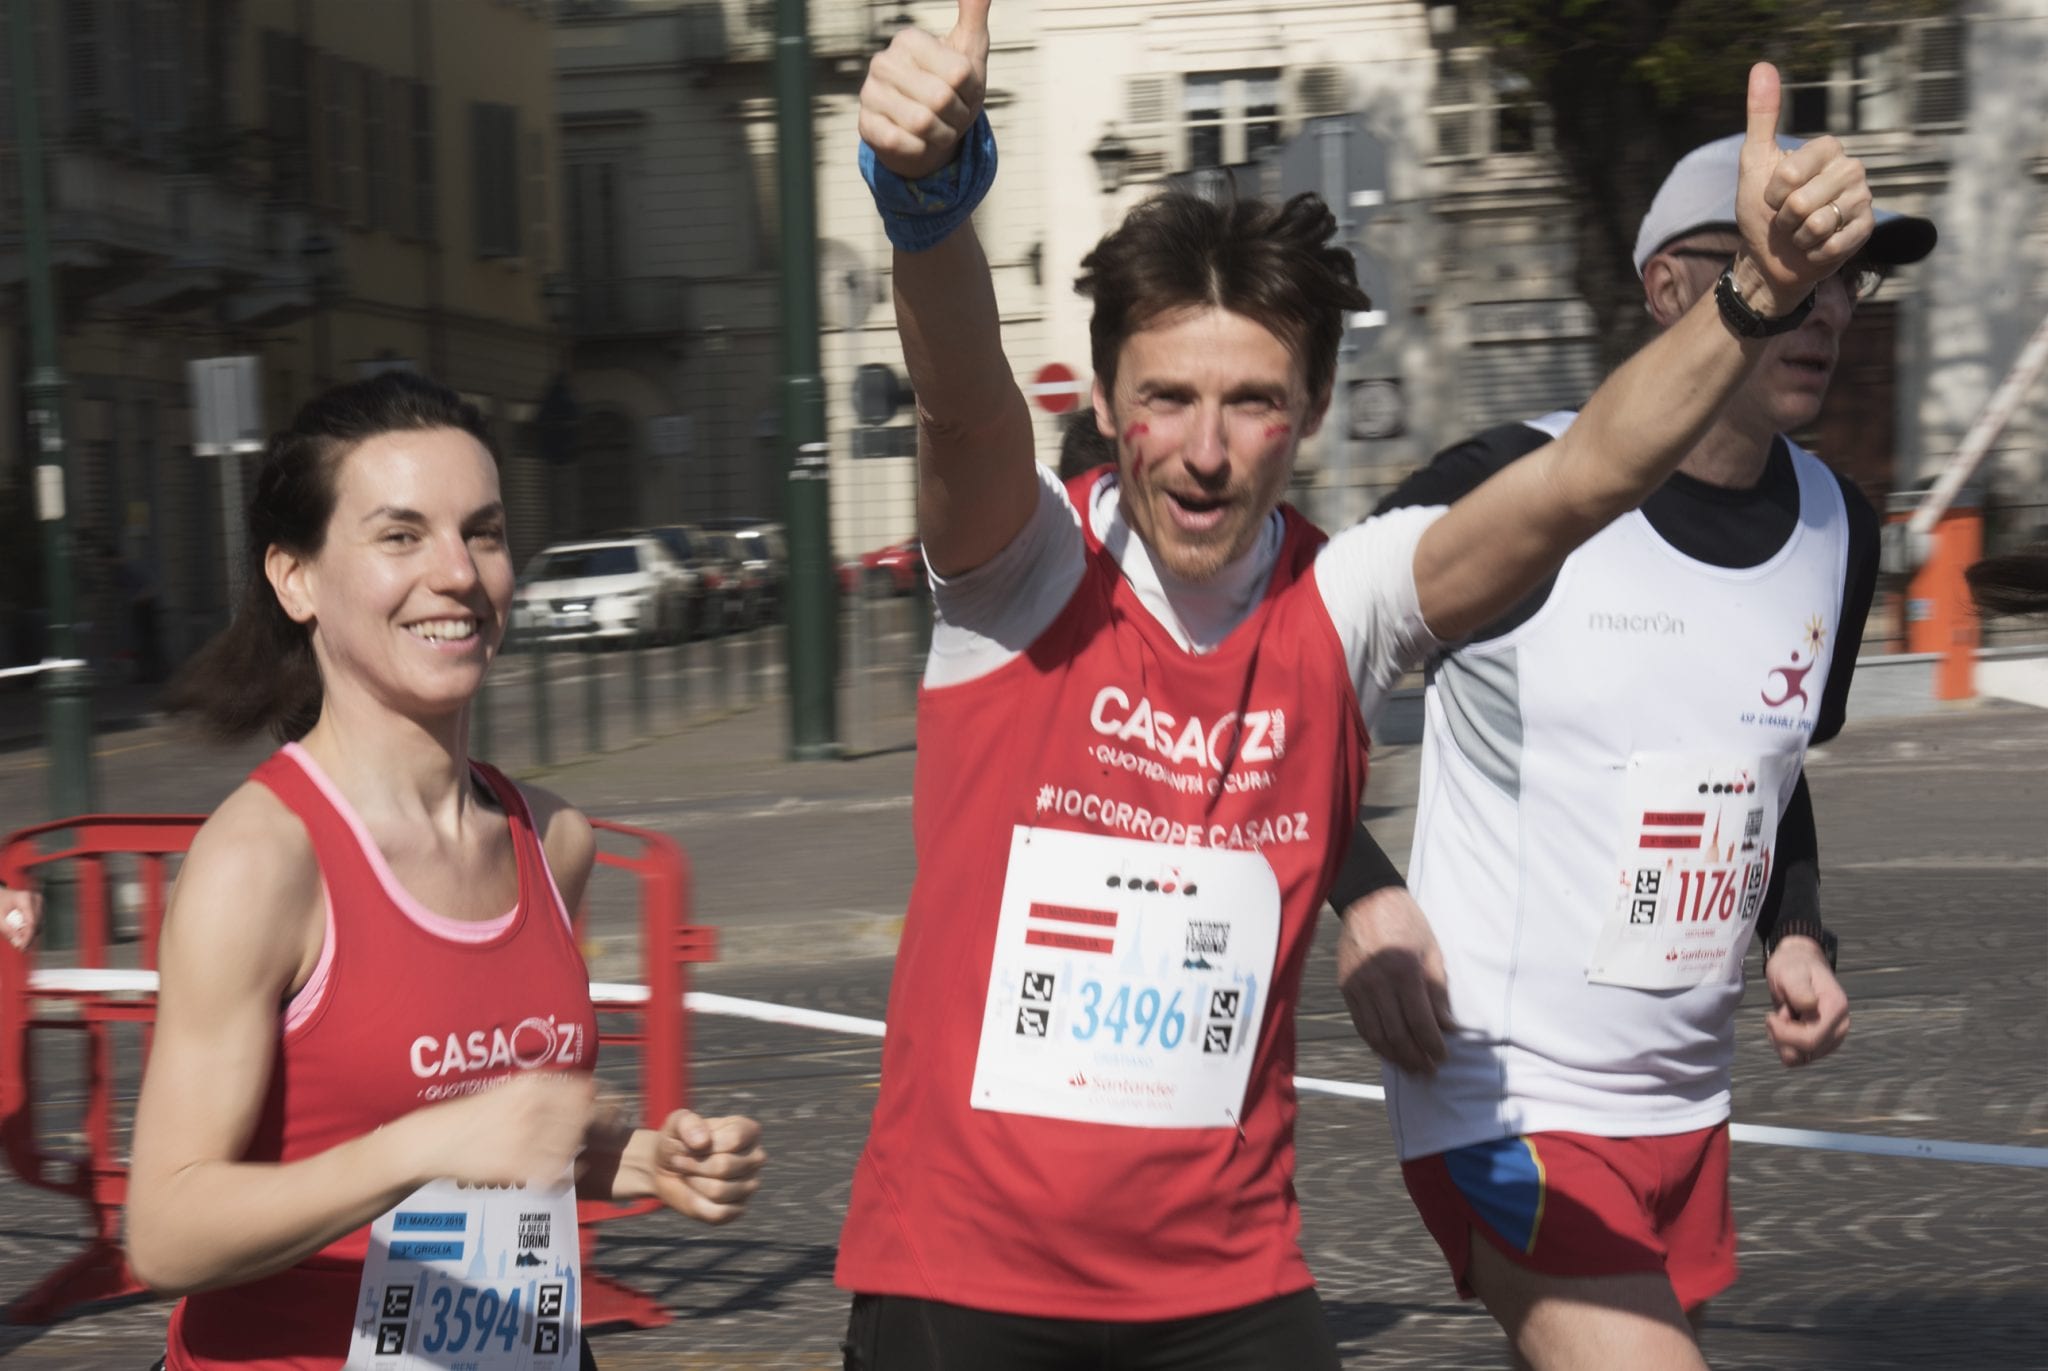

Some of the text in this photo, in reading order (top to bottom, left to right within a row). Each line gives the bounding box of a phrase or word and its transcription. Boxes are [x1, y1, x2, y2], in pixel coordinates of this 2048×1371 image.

[1676, 870, 1738, 923] 1176
[1071, 980, 1186, 1050] 3496
[518, 1234, 550, 1249] TORINO
[423, 1287, 521, 1353] 3594
